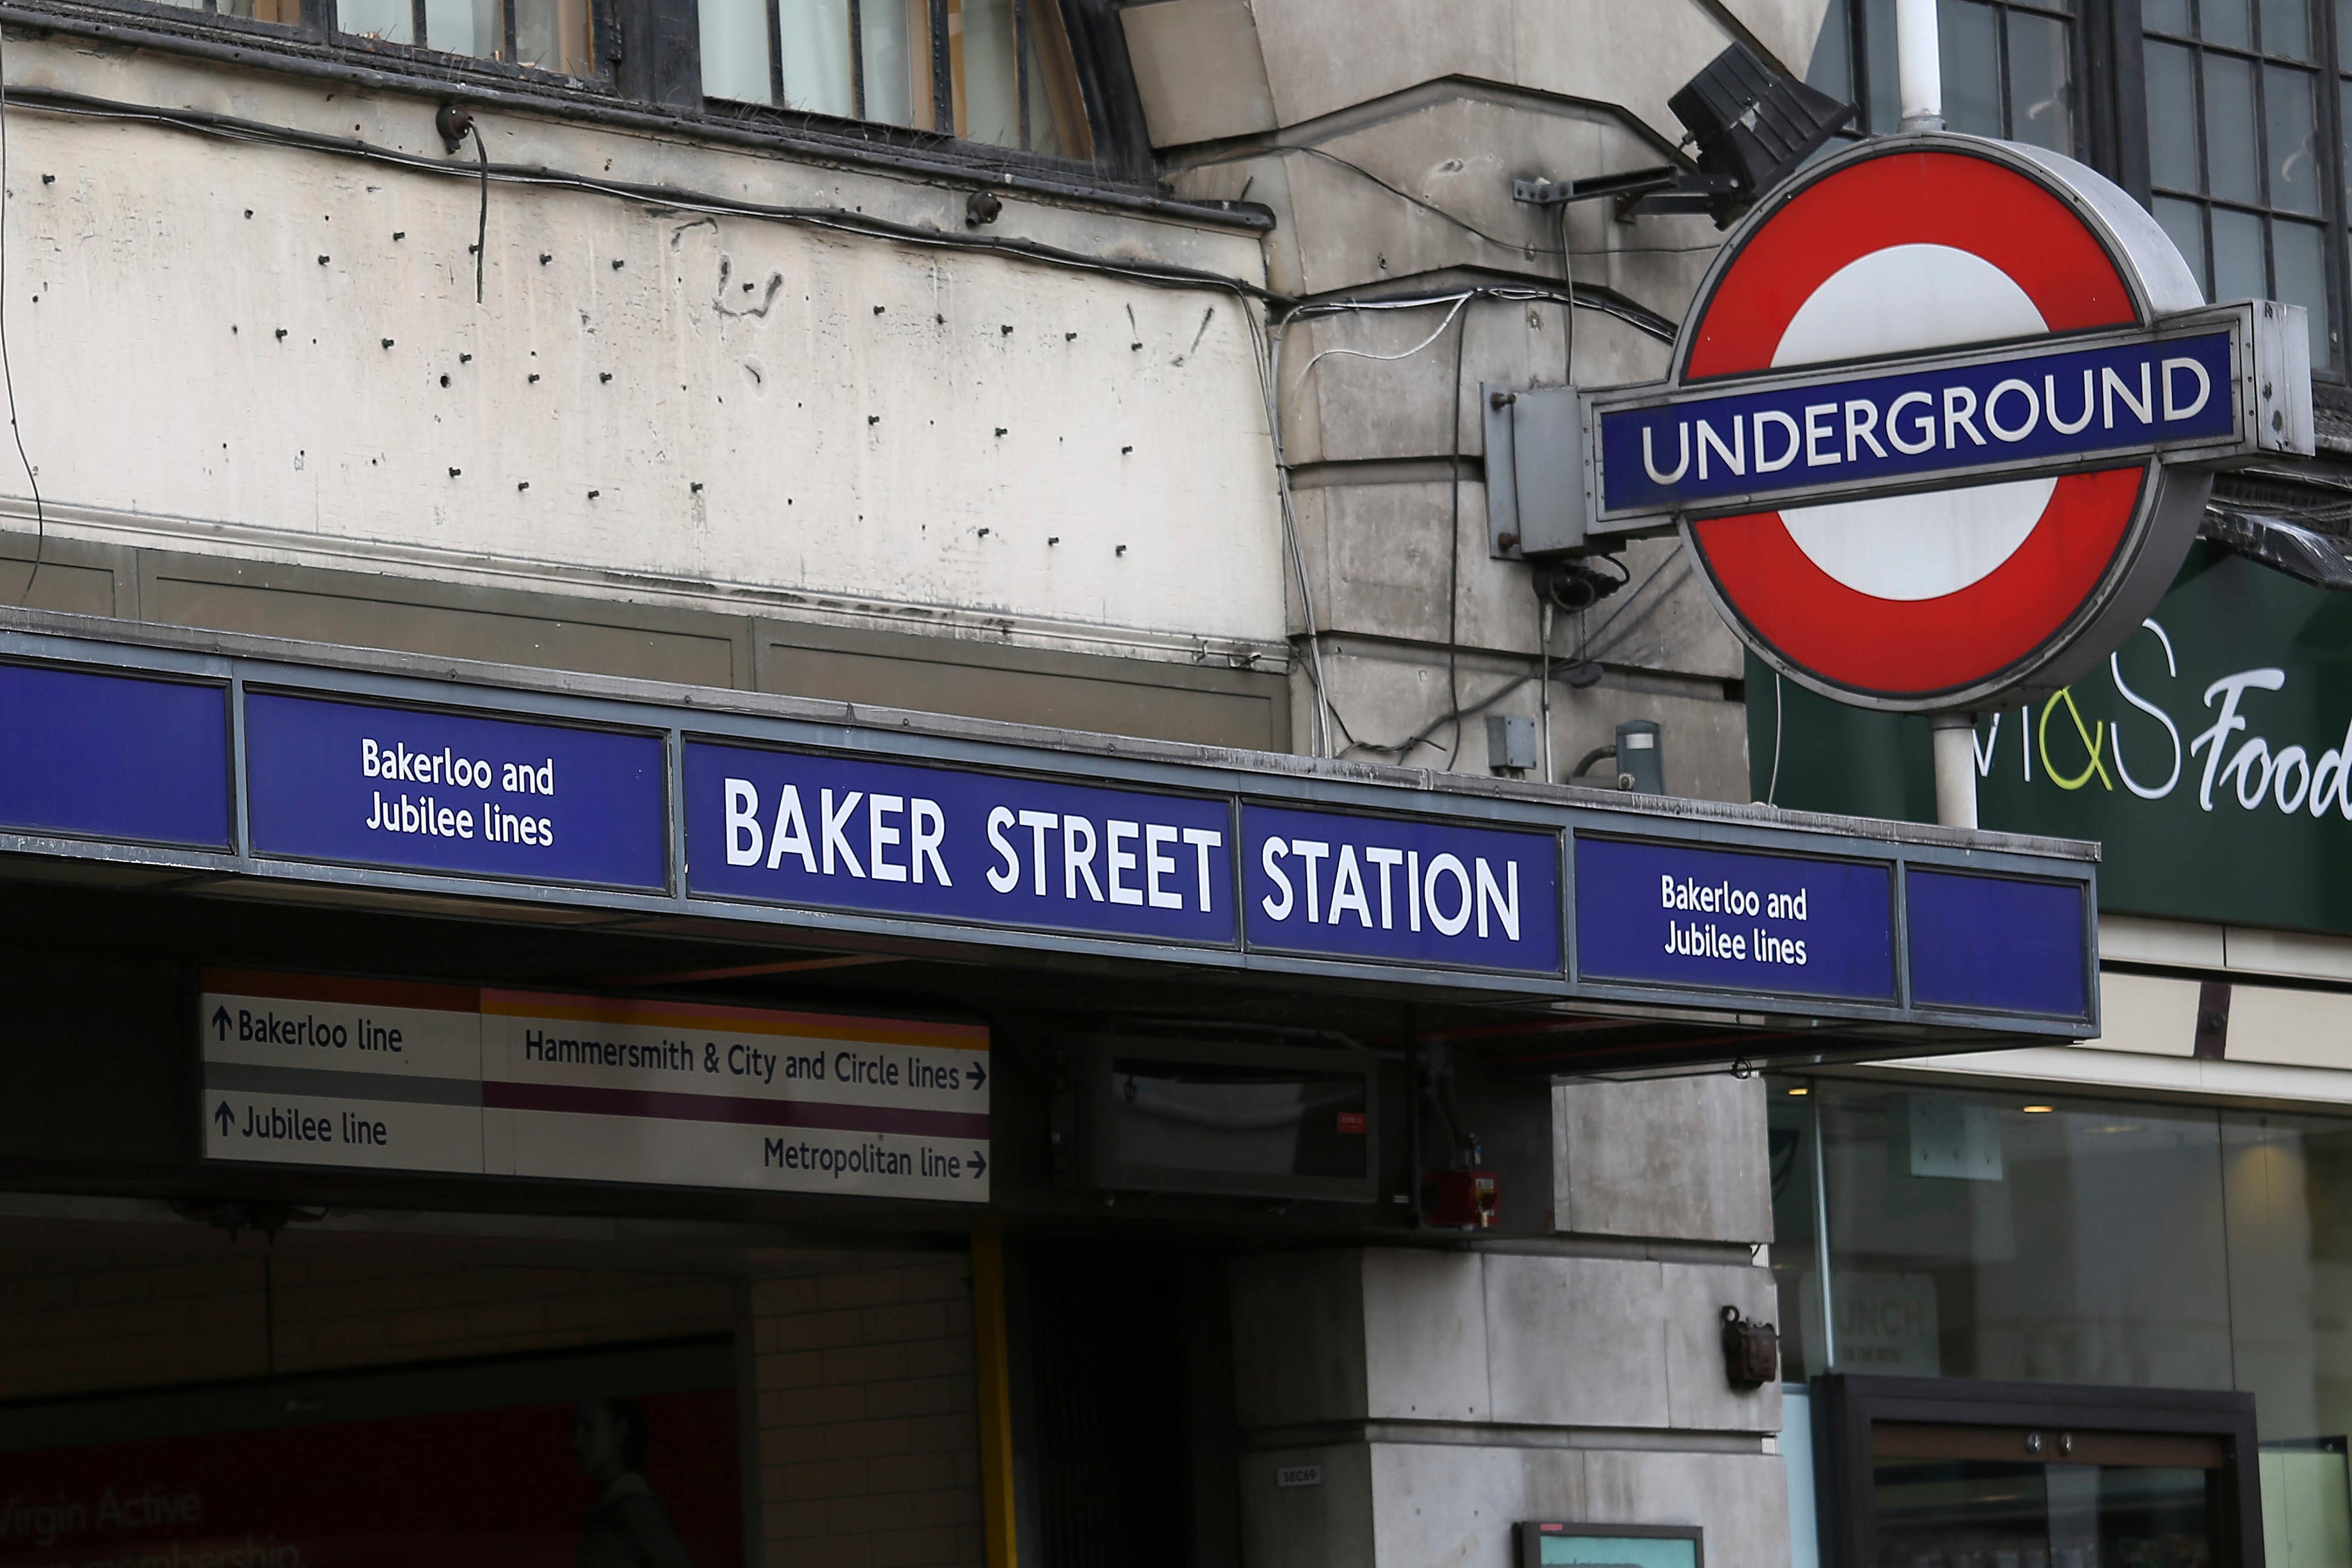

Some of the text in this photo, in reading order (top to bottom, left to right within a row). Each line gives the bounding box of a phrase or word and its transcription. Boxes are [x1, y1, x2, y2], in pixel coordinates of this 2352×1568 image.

[1641, 356, 2211, 485] UNDERGROUND
[362, 738, 554, 796] Bakerloo and
[366, 791, 554, 847] Jubilee lines
[724, 778, 1521, 941] BAKER STREET STATION
[1661, 874, 1807, 922] Bakerloo and
[1664, 920, 1807, 966] Jubilee lines
[238, 1009, 403, 1053] Bakerloo line
[525, 1028, 961, 1091] Hammersmith & City and Circle lines
[241, 1105, 388, 1146] Jubilee line
[764, 1137, 961, 1179] Metropolitan line
[98, 1487, 202, 1530] Active
